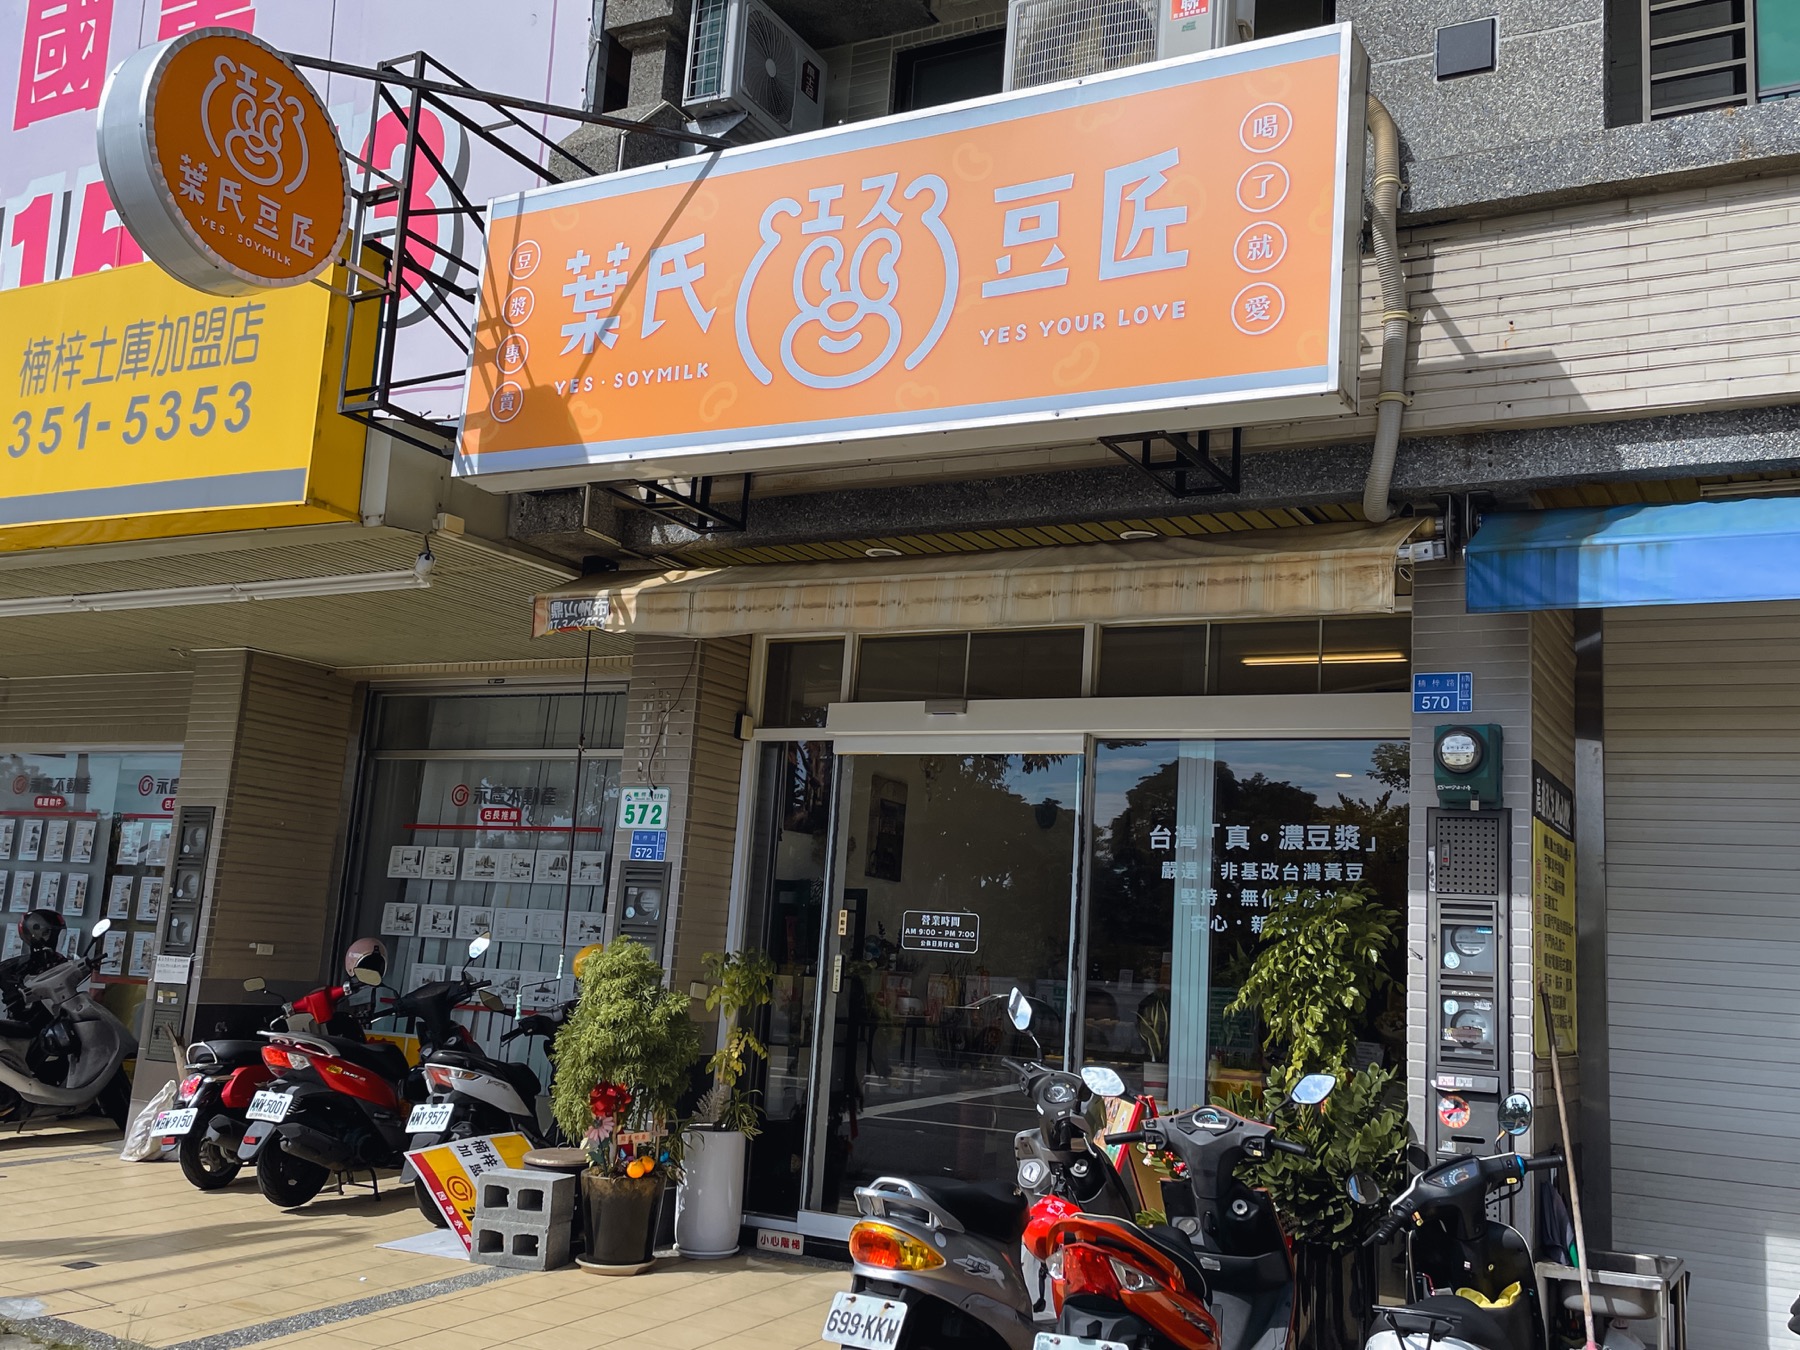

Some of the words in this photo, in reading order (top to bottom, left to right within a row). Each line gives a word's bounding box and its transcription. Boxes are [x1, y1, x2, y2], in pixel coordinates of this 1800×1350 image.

[179, 154, 315, 257] 葉氏豆匠
[979, 323, 1027, 346] YES
[1039, 312, 1106, 338] YOUR
[1117, 301, 1186, 327] LOVE
[19, 301, 267, 398] 楠梓土庫加盟店
[7, 381, 253, 459] 351-5353
[1421, 696, 1450, 709] 570
[624, 804, 662, 824] 572
[634, 847, 652, 858] 572
[918, 928, 936, 936] 9:00
[760, 1234, 800, 1250] 小心階梯
